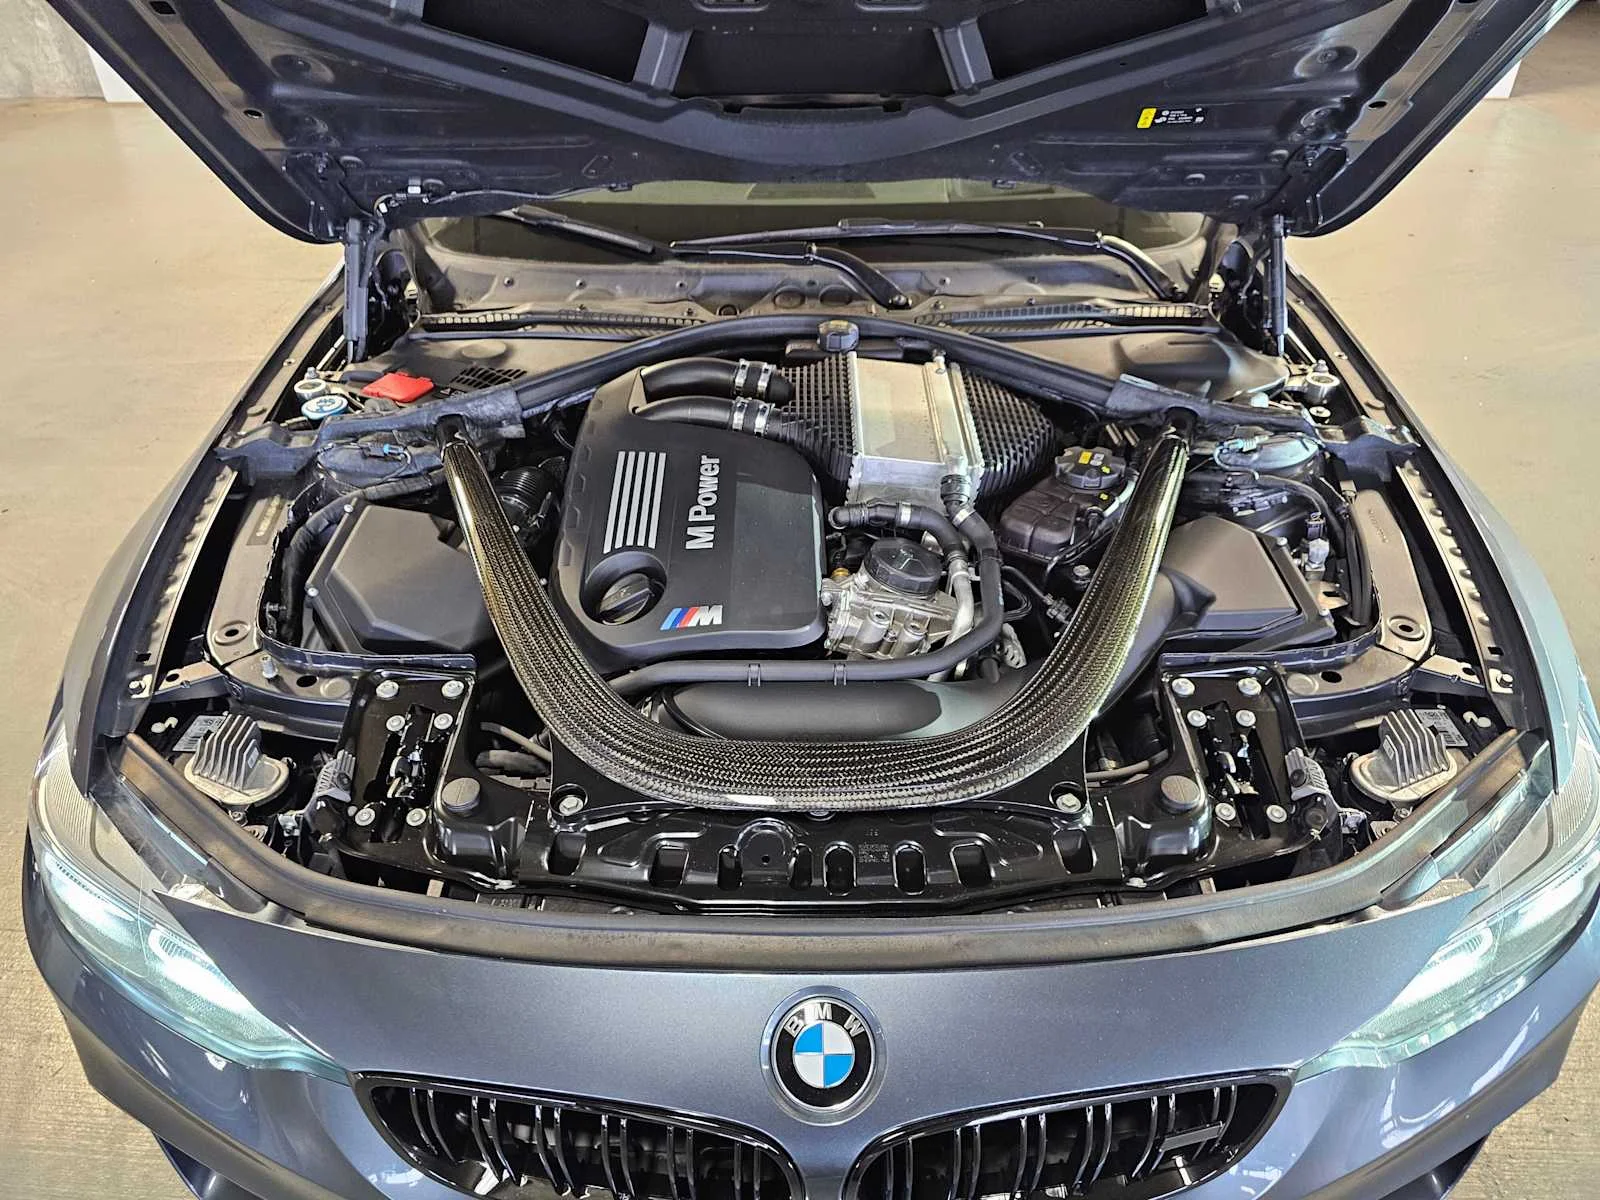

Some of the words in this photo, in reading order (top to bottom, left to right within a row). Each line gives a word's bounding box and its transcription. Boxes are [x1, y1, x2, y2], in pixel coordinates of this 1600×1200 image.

[688, 454, 720, 522] Power
[685, 525, 715, 550] M
[783, 1002, 865, 1038] BMW
